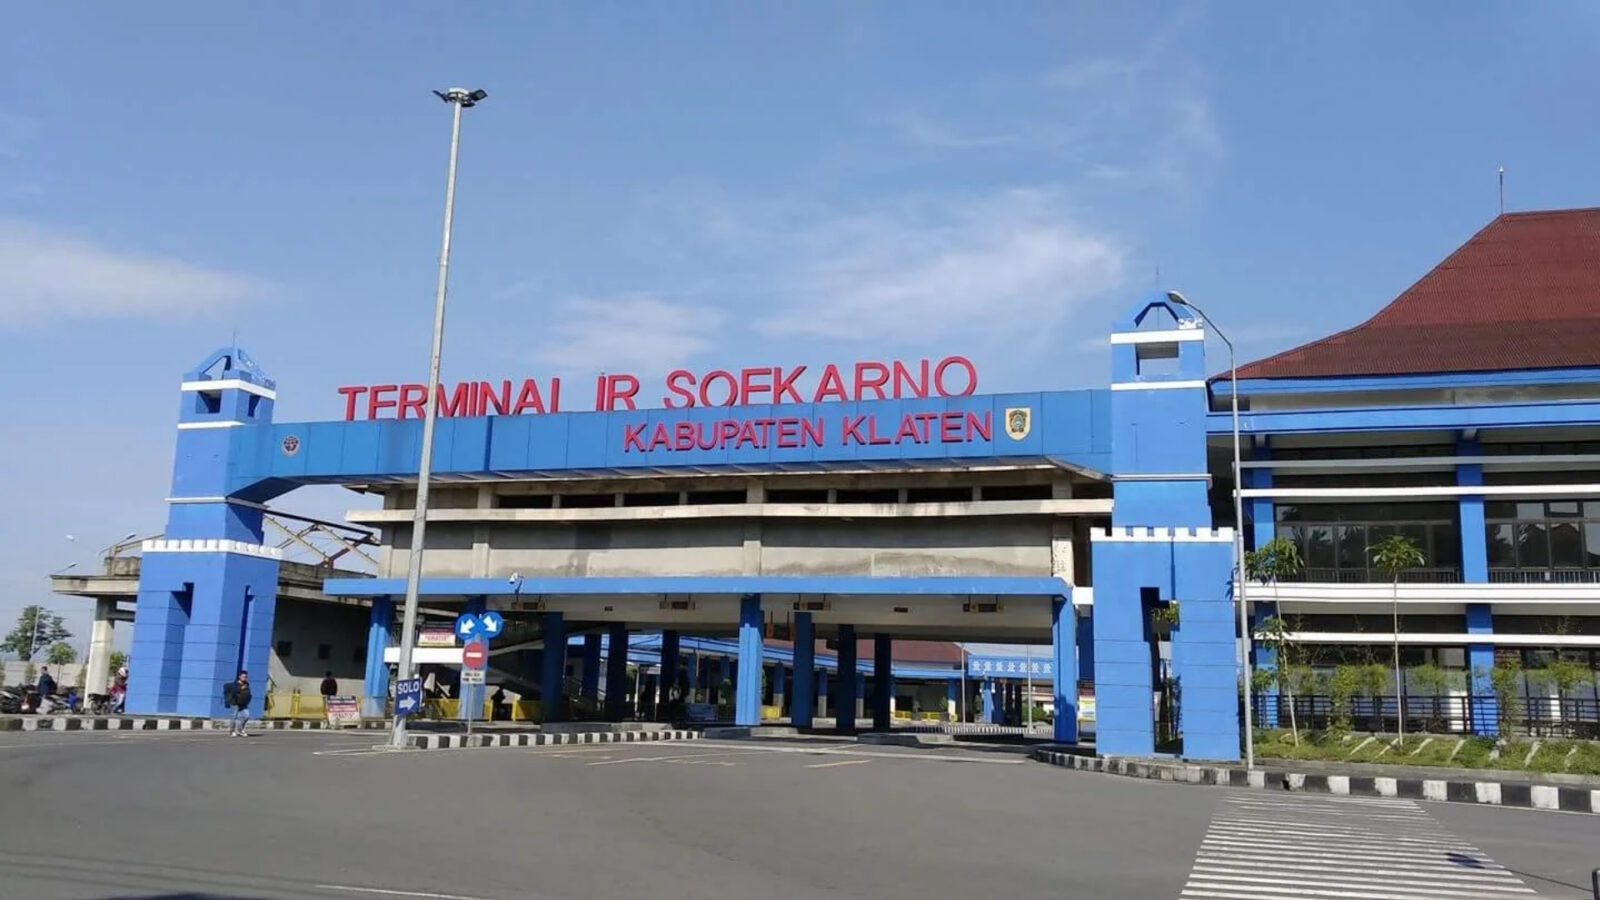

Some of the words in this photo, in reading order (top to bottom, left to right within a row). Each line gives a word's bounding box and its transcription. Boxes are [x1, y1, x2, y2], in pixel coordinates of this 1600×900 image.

[596, 374, 640, 412] IR
[664, 356, 977, 410] SOEKARNO
[624, 417, 825, 453] KABUPATEN
[842, 410, 992, 446] KLATEN
[398, 681, 419, 694] SOLO
